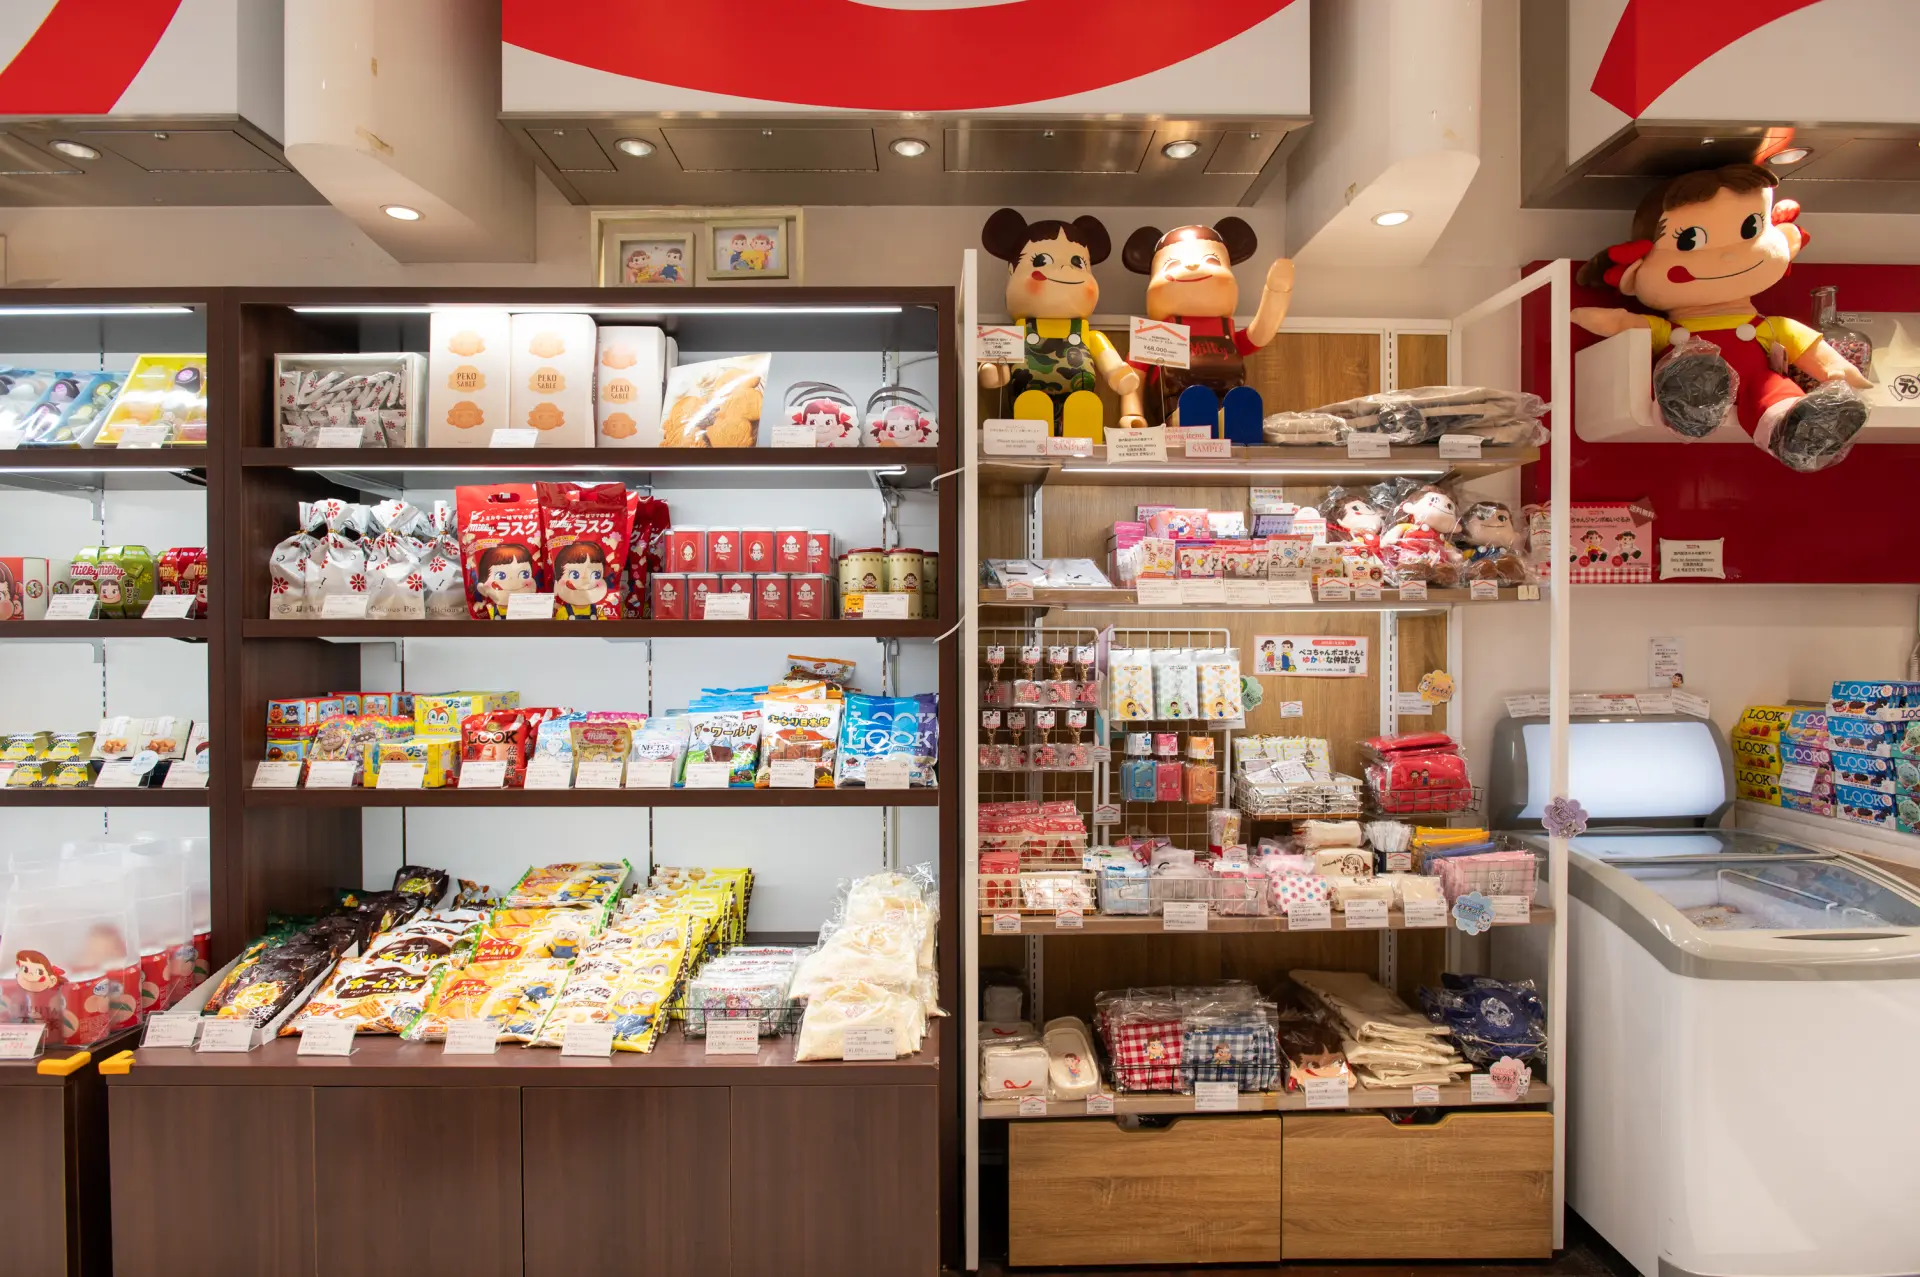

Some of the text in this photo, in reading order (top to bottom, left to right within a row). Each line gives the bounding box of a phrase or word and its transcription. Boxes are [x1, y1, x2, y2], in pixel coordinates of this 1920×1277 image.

[610, 384, 630, 392] PEKO
[1898, 382, 1918, 394] 70
[1192, 444, 1224, 452] SAMPLE
[496, 522, 538, 536] ラスク
[575, 520, 614, 534] ラスク
[71, 565, 98, 580] Milky
[98, 565, 126, 580] Milky
[1302, 656, 1361, 664] ゆかいな仲間たち
[1839, 684, 1882, 698] LOOK
[1748, 708, 1784, 722] LOOK
[845, 722, 933, 748] LOOK
[1834, 720, 1876, 736] LOOK
[468, 731, 518, 744] LOOK
[1738, 740, 1770, 755] LOOK
[1784, 747, 1820, 764] LOOK
[1838, 754, 1878, 772] LOOK
[1740, 771, 1771, 786] LOOK
[1843, 788, 1885, 807] LOOK
